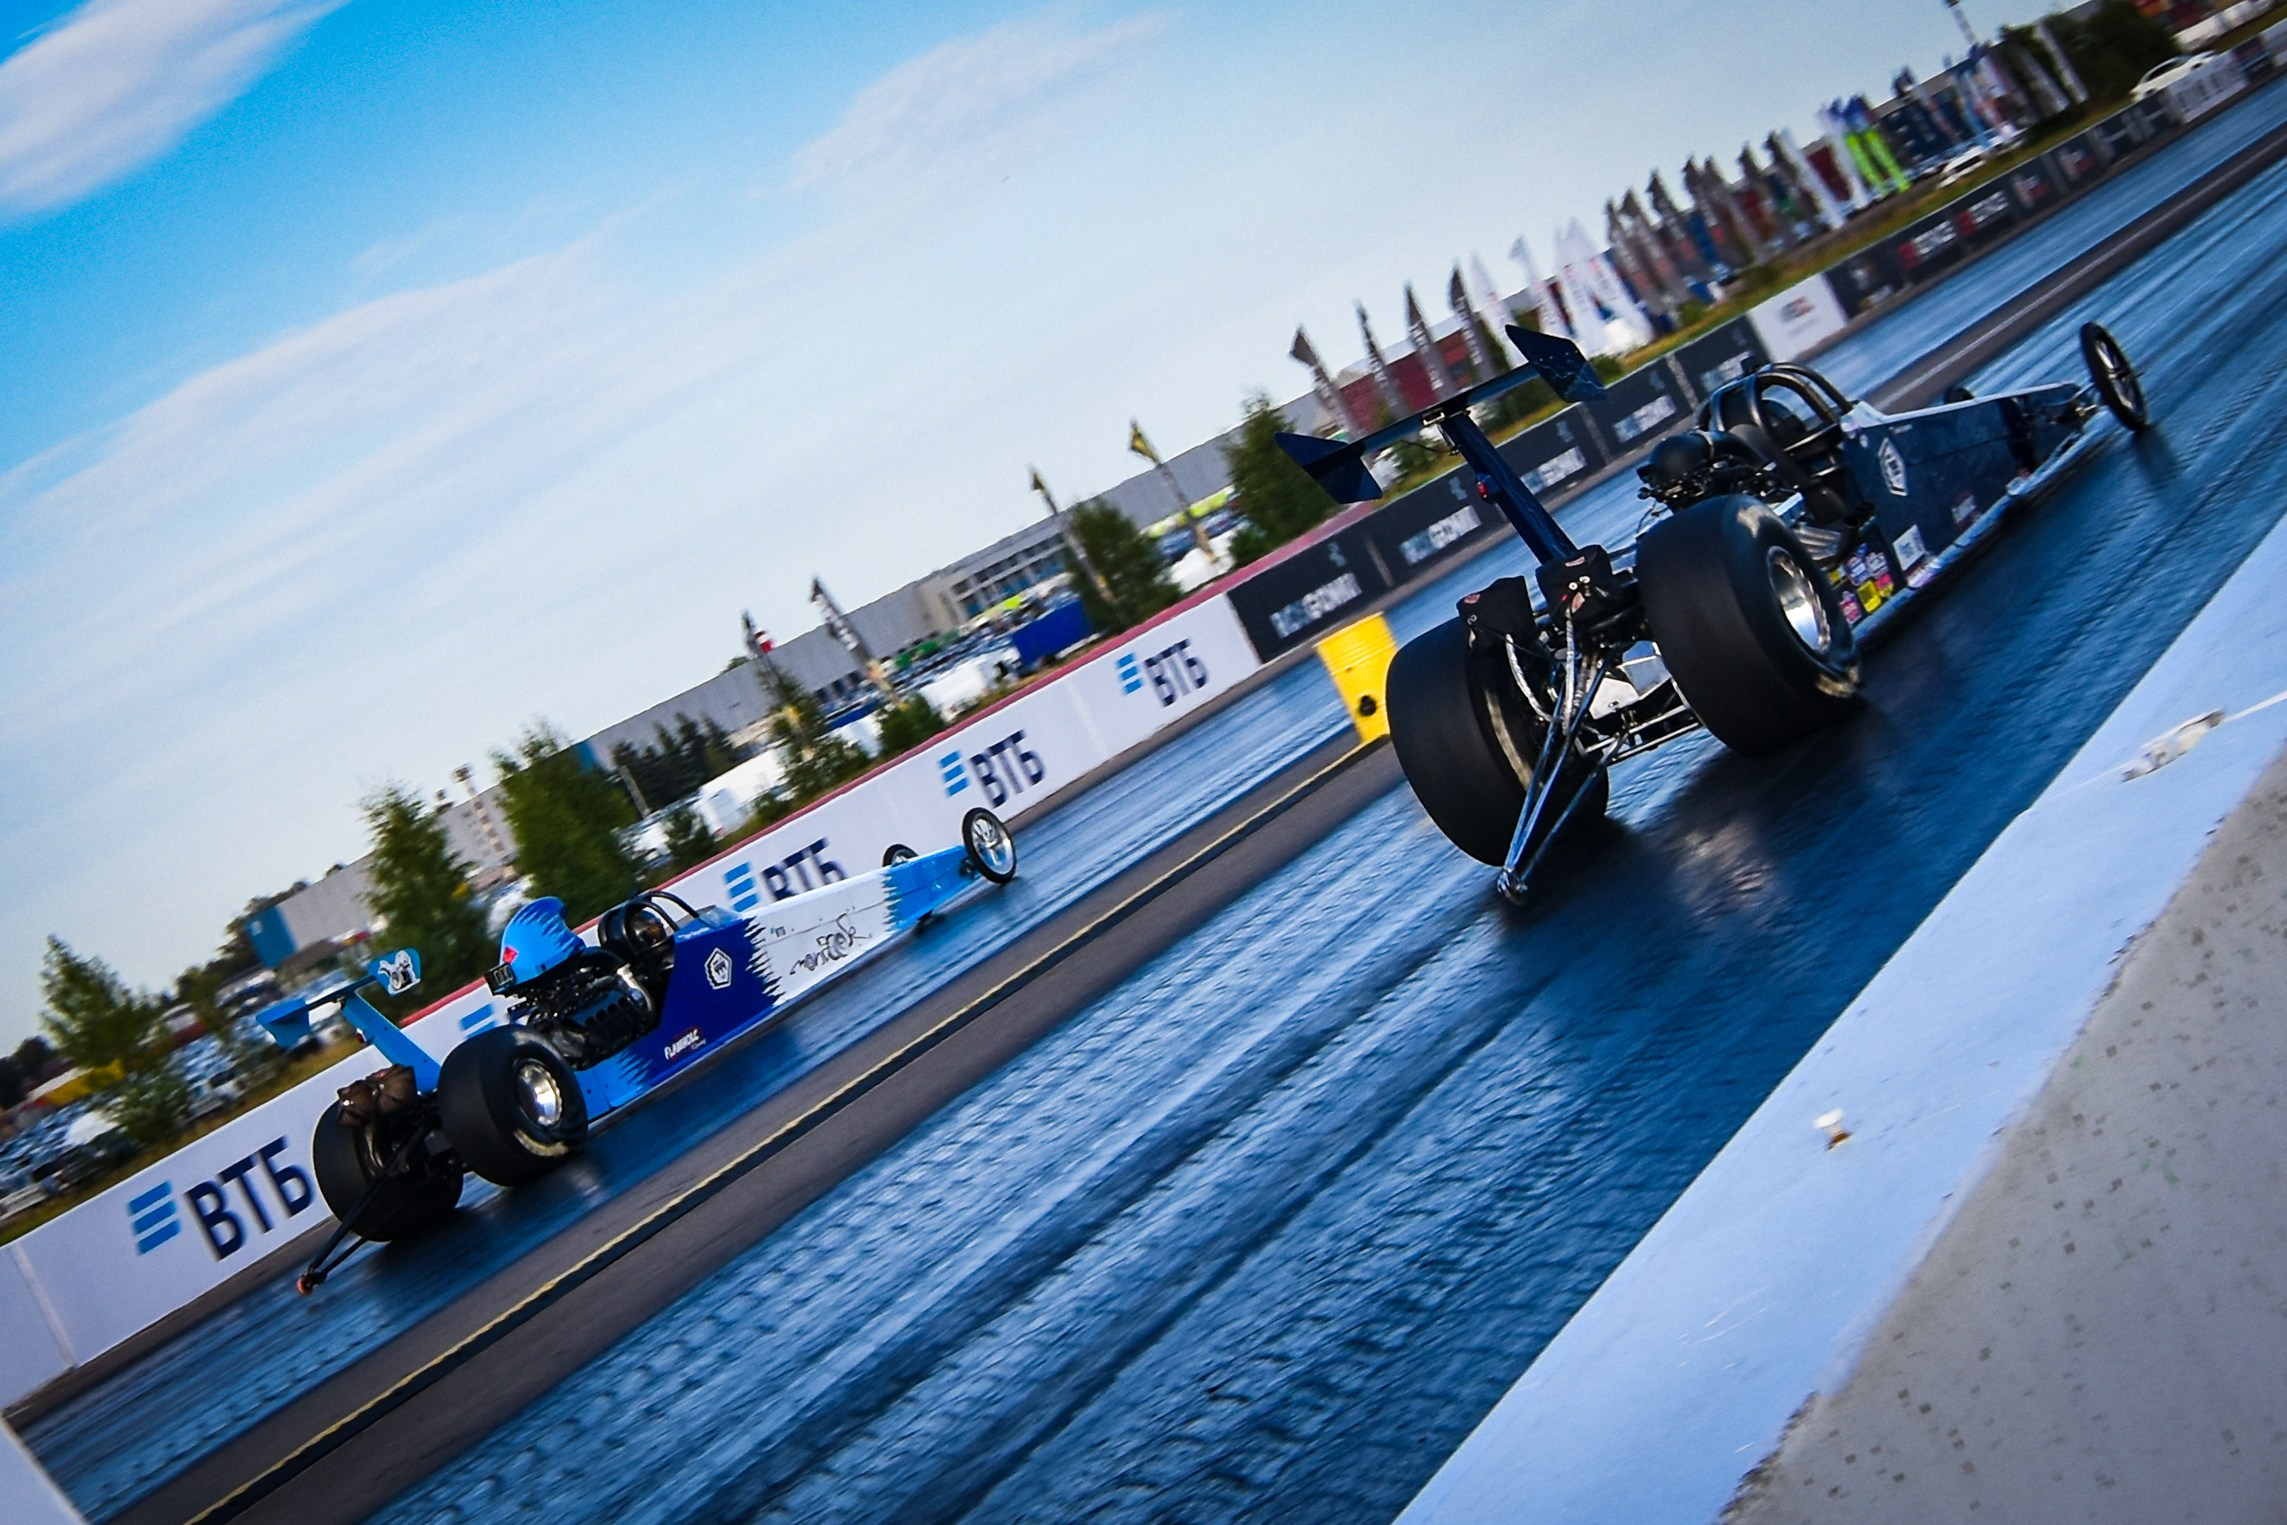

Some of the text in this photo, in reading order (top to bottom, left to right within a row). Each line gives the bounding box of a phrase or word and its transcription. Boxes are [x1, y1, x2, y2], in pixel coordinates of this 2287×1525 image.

[1143, 639, 1208, 707] ВТБ
[969, 729, 1045, 809] ВТБ
[183, 1135, 315, 1262] ВТБ
